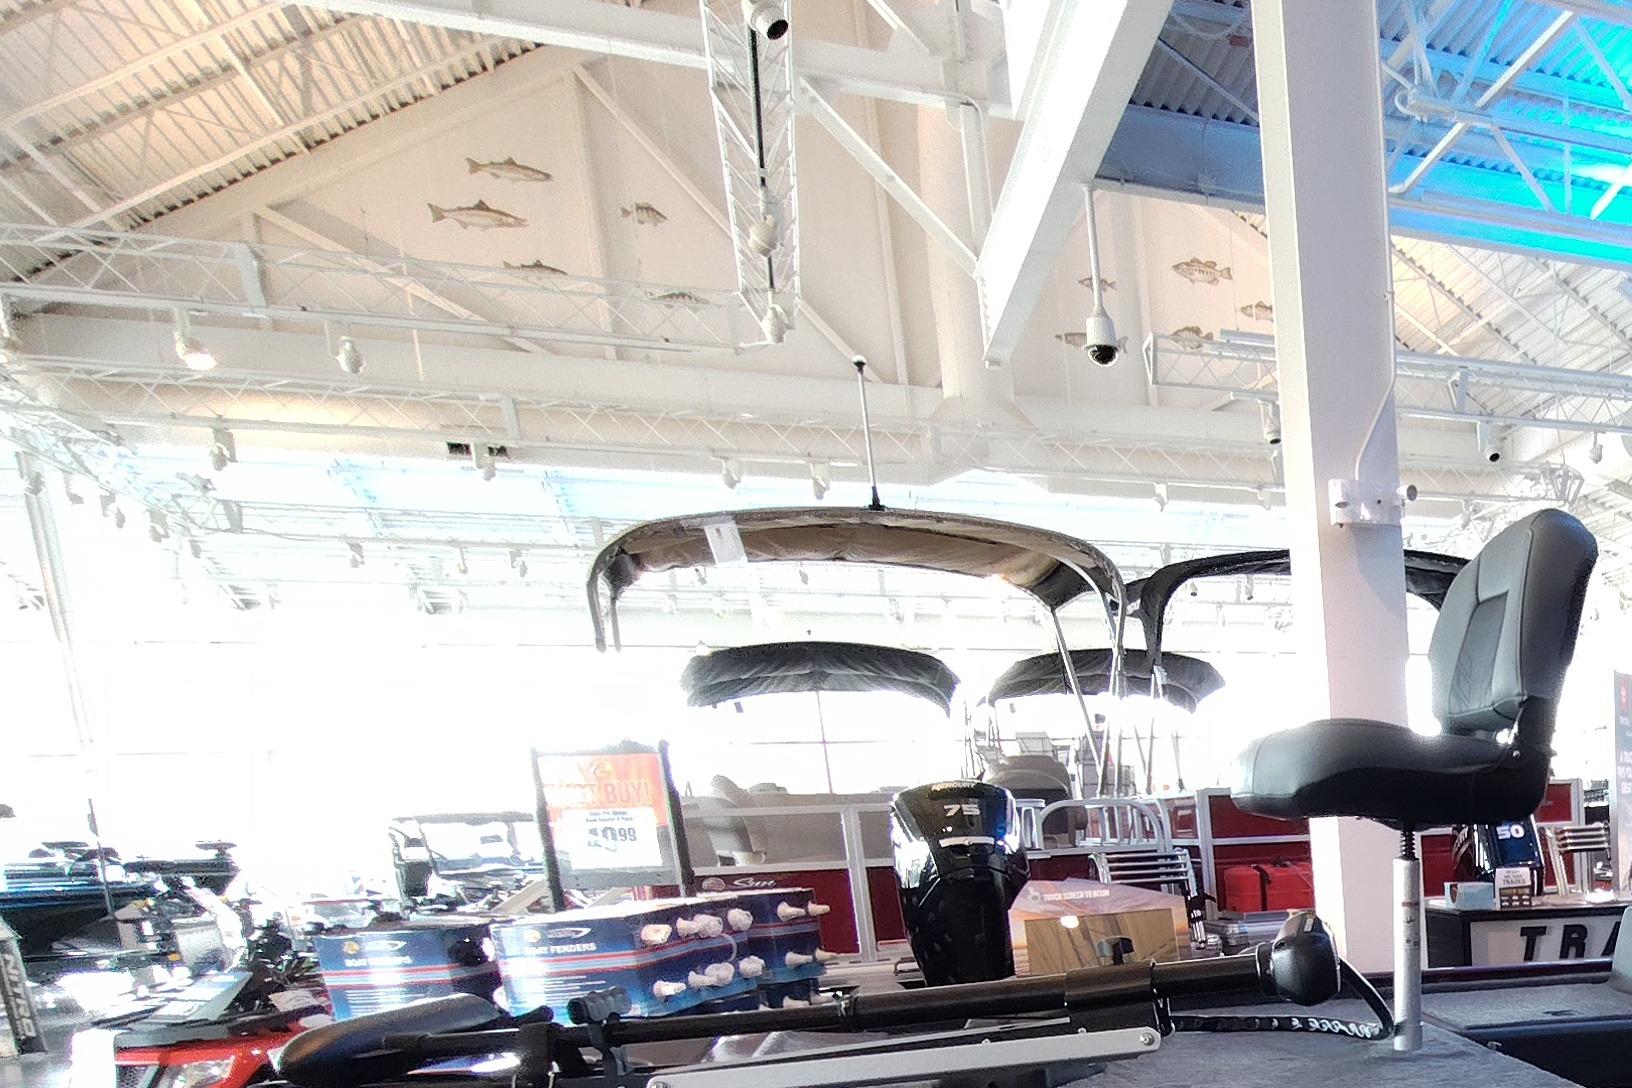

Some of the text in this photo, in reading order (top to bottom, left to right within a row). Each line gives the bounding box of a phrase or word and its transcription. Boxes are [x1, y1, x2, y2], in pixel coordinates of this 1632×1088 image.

[944, 803, 981, 817] 75
[1496, 823, 1526, 840] 50
[548, 942, 597, 954] FENDERS
